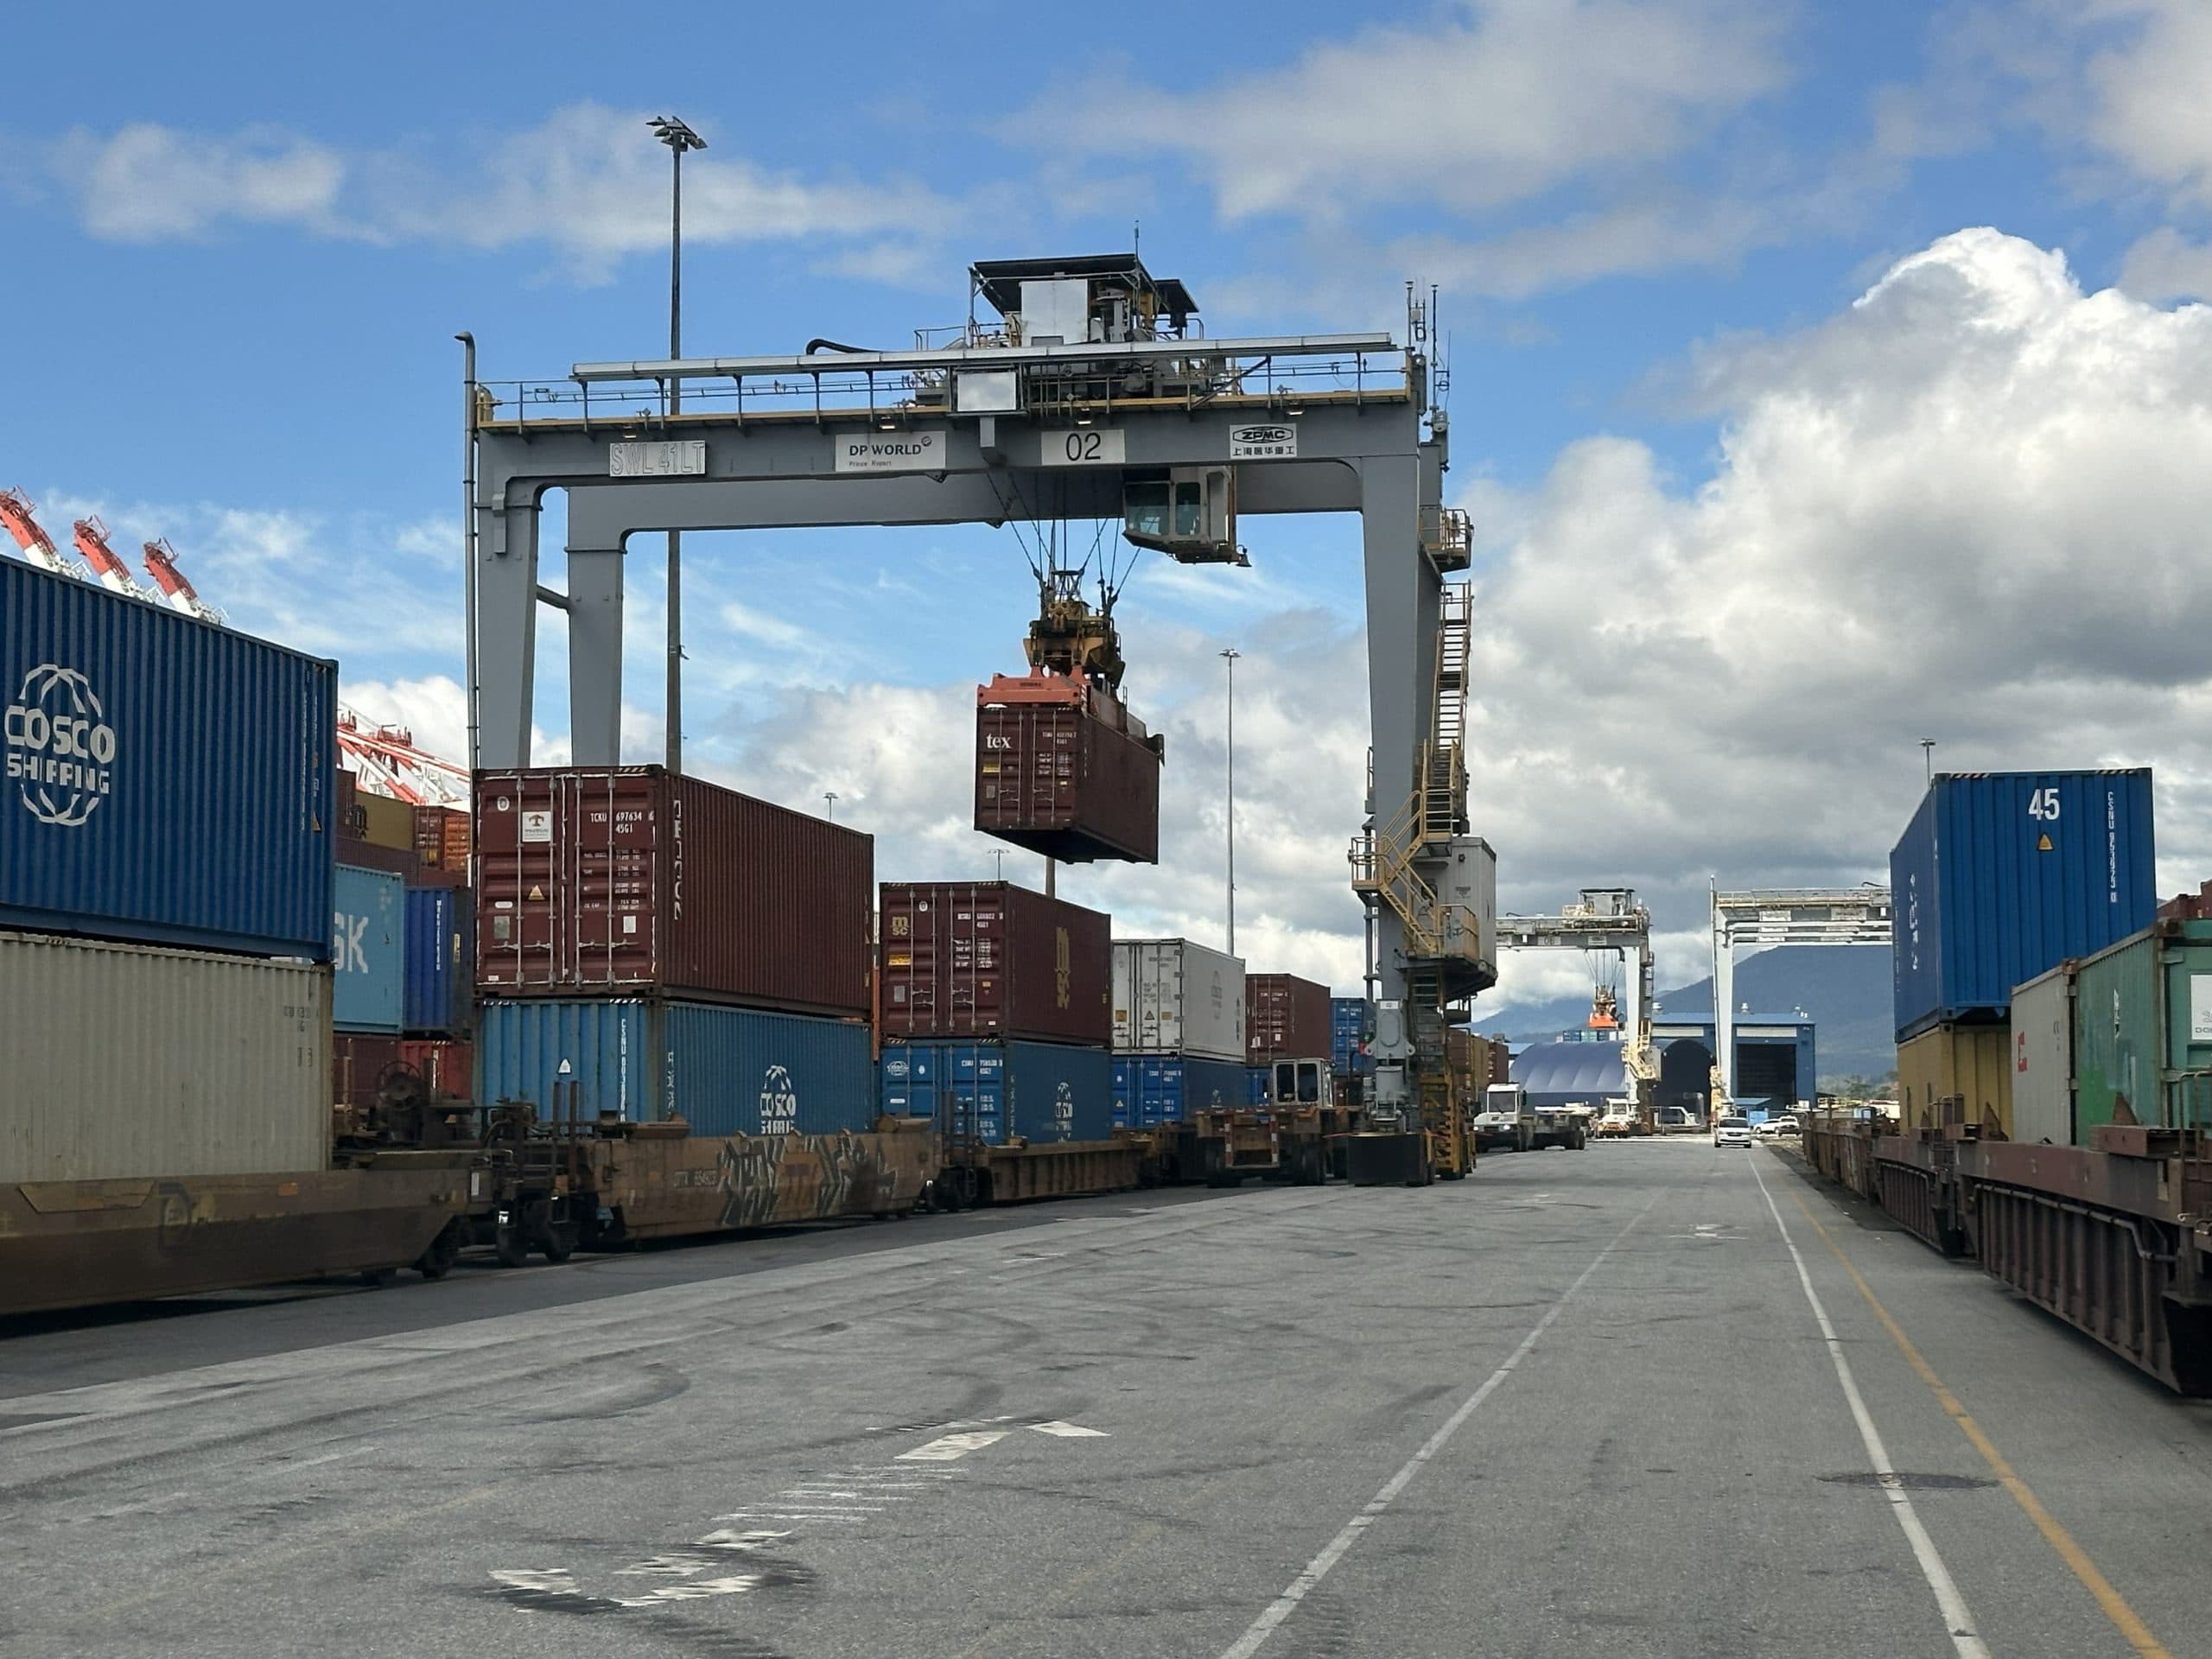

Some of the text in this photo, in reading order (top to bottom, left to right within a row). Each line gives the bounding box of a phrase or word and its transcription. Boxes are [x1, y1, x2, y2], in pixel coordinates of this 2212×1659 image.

[849, 444, 922, 456] DP WORLD
[1065, 433, 1102, 461] 02
[1242, 430, 1286, 442] ZPMC
[610, 442, 705, 475] SWL 41LT
[4, 704, 116, 765] COSCO
[986, 733, 1012, 749] tex
[7, 753, 110, 794] SHIPPING
[590, 813, 607, 823] TCKU
[2028, 788, 2060, 820] 45
